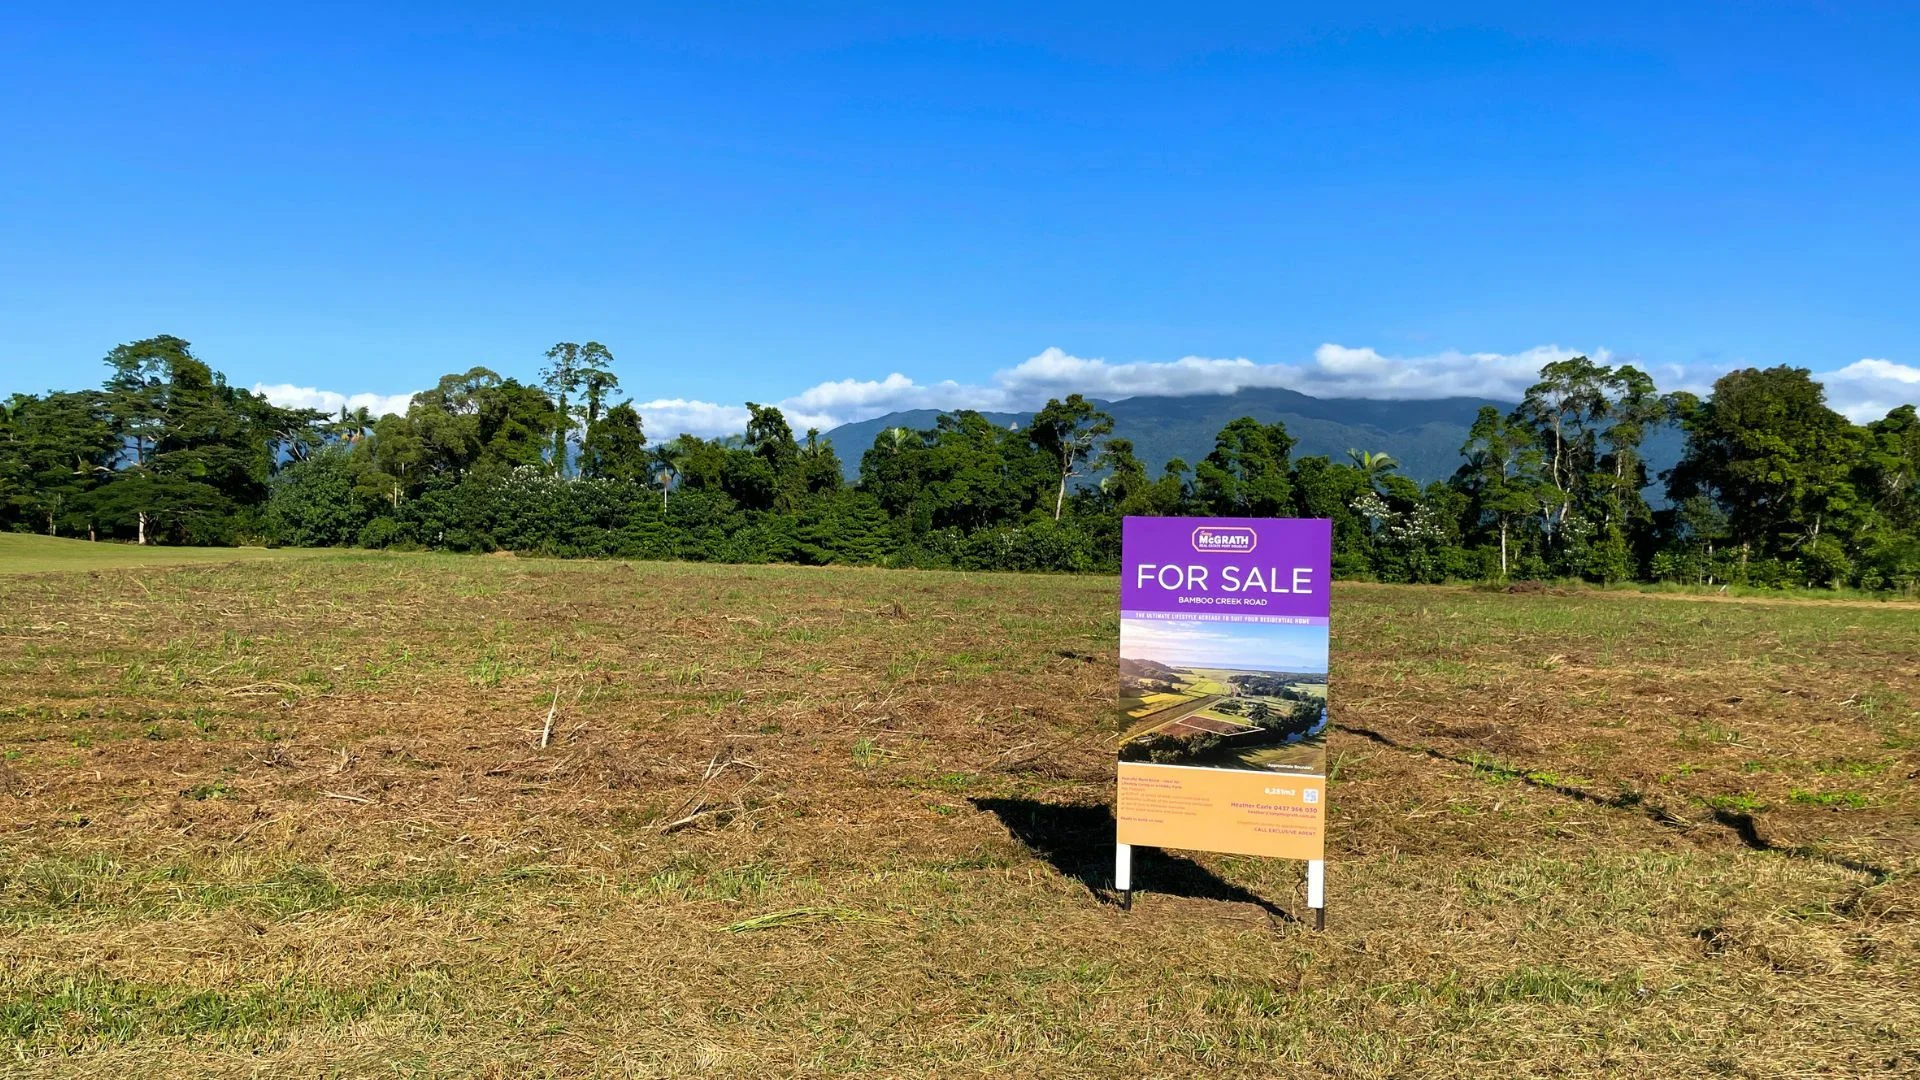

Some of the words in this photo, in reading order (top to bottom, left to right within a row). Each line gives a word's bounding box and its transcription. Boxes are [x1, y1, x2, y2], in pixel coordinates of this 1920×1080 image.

[1199, 535, 1249, 544] McGRATH
[1137, 564, 1208, 590] FOR
[1220, 565, 1313, 594] SALE
[1178, 596, 1214, 605] BAMBOO
[1215, 597, 1242, 606] CREEK
[1243, 598, 1268, 607] ROAD
[1171, 613, 1197, 621] LIFESTYLE
[1260, 616, 1293, 624] RESIDENTIAL
